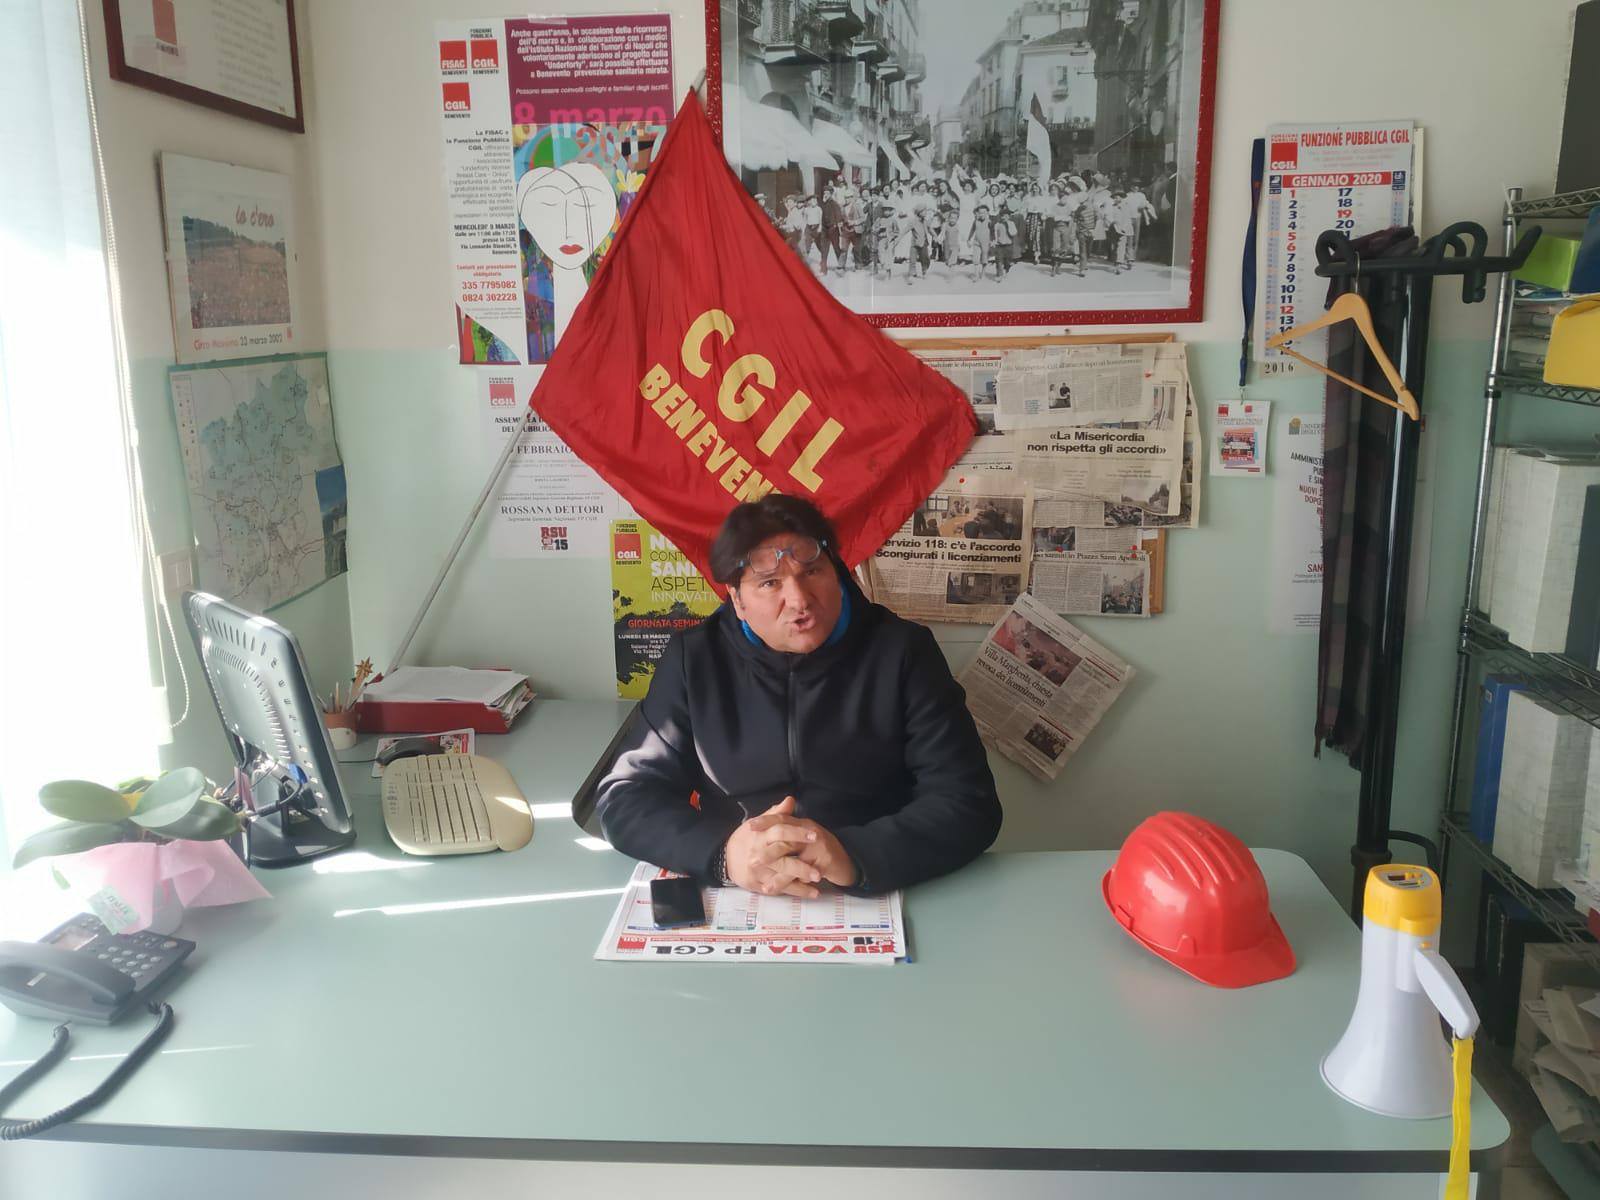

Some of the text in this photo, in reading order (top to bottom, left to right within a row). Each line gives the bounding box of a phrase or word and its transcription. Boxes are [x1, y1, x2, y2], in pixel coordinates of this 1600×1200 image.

[511, 29, 531, 37] Anche
[581, 26, 614, 35] occasione
[616, 26, 631, 34] della
[633, 26, 667, 34] ricorrenza
[568, 36, 574, 44] in
[578, 35, 625, 44] collaborazione
[645, 33, 668, 41] medici
[555, 44, 588, 53] Nazionale
[589, 43, 600, 52] dei
[601, 43, 624, 51] Tumori
[633, 42, 654, 51] Napoli
[523, 53, 576, 62] volontariamente
[577, 52, 613, 60] aderiscono
[622, 50, 650, 60] progetto
[652, 49, 668, 58] della
[442, 60, 465, 68] FISAC
[474, 58, 497, 68] CGIL
[590, 58, 669, 68] sarà possibile effettuare
[536, 70, 571, 78] Benevento
[574, 69, 613, 78] prevenzione
[615, 68, 644, 76] sanitaria
[646, 66, 669, 75] mirata.
[445, 101, 468, 110] CGIL
[514, 102, 667, 147] 8 marzo
[1301, 129, 1409, 147] FUNZIONE PUBBLICA CGIL
[576, 124, 667, 167] 2017
[1271, 161, 1297, 169] CGIL
[1292, 173, 1382, 187] GENNAIO 2020
[1290, 188, 1352, 198] 1 17
[1288, 199, 1352, 209] 2 18
[1288, 209, 1352, 219] 3 19
[1336, 220, 1354, 228] 20
[1288, 232, 1296, 240] 5
[1287, 243, 1296, 251] 6
[1288, 254, 1296, 262] 7
[1287, 264, 1296, 272] 8
[1286, 274, 1295, 283] 9
[1281, 285, 1295, 293] 10
[1281, 295, 1293, 303] 11
[1280, 306, 1294, 314] 12
[1280, 316, 1294, 324] 13
[249, 335, 268, 346] marzo
[1265, 363, 1294, 373] 2016
[682, 309, 844, 494] CGIL
[639, 363, 782, 502] BENEVEN
[1050, 431, 1144, 442] «La Misericordia
[1052, 444, 1096, 454] rispetta
[1099, 443, 1113, 454] gli
[1116, 444, 1166, 454] accordi»
[1300, 484, 1318, 496] NUOVI
[501, 504, 604, 515] ROSSANA DETTORI
[540, 527, 567, 538] RSU
[554, 539, 568, 550] 15
[884, 539, 1021, 552] ervizio 118: c'è l'accordo
[650, 551, 687, 562] CONT
[876, 549, 1021, 563] Scongiurati i licenziamenti
[652, 577, 705, 592] ASPET
[628, 620, 671, 628] GIORNATA
[984, 646, 1000, 662] Villa
[1032, 681, 1053, 698] chiesta
[976, 658, 1046, 707] revoca dei licenziamenti
[651, 945, 714, 954] CGIL
[724, 945, 757, 954] FP
[769, 945, 848, 954] VOTA
